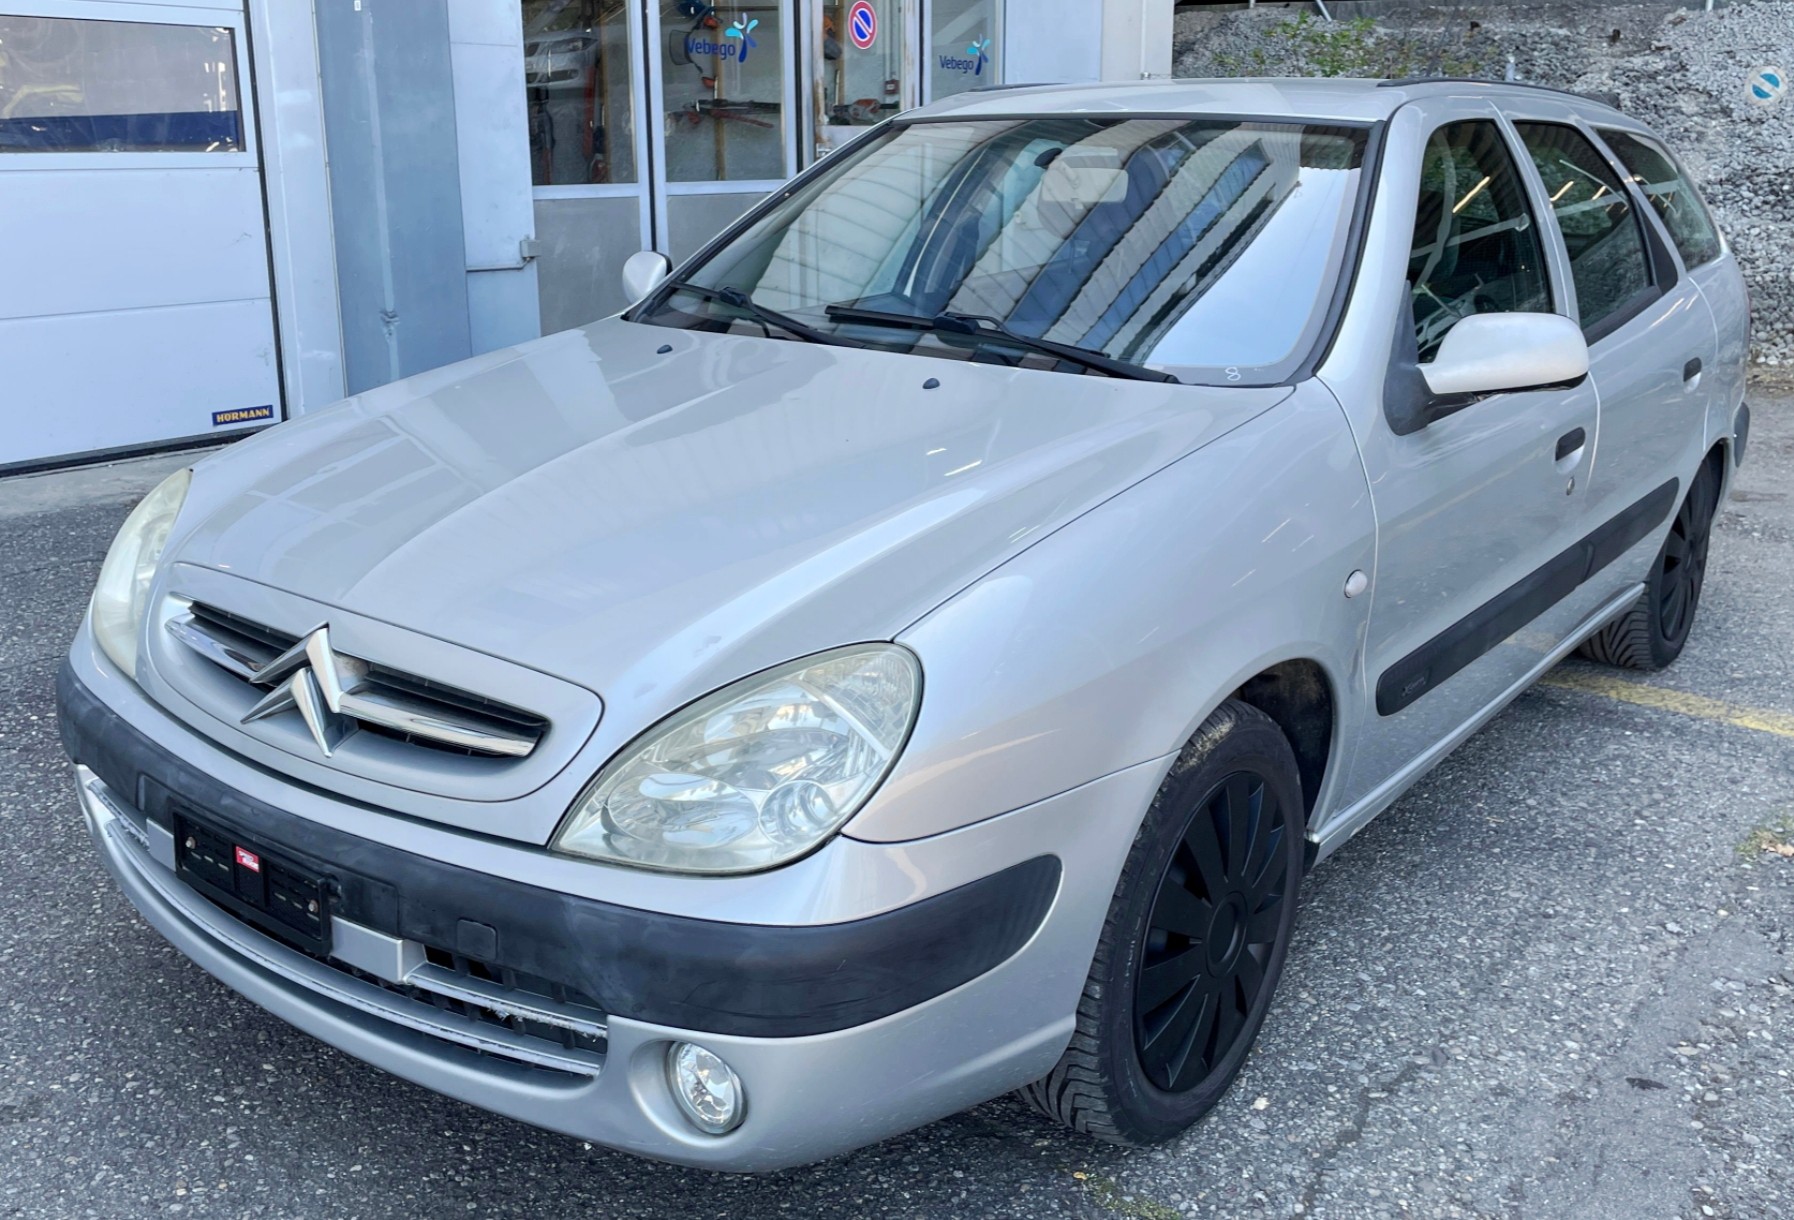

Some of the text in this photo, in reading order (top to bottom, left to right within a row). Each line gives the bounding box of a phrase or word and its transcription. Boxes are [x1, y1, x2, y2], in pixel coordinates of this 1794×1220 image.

[685, 37, 736, 61] Vebego
[939, 55, 974, 74] Vebego
[1225, 366, 1241, 381] 8
